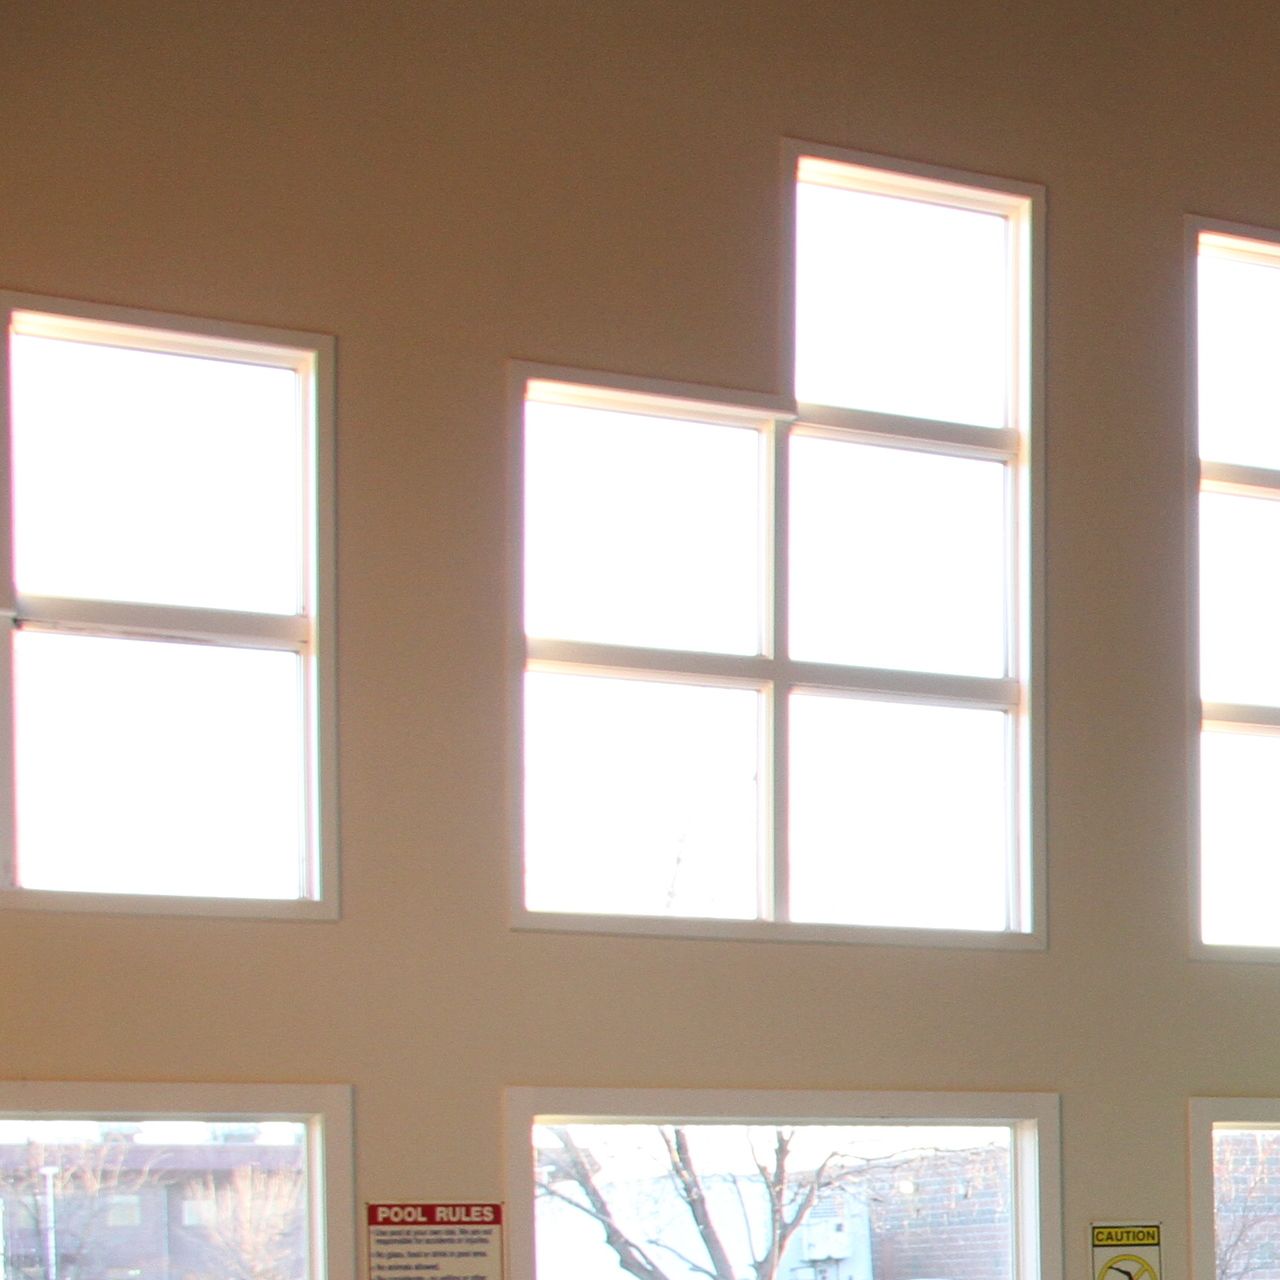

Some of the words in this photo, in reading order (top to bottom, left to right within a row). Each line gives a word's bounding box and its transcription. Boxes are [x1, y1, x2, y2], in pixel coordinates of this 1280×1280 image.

[377, 1207, 427, 1221] POOL
[436, 1207, 494, 1221] RULES
[1095, 1231, 1155, 1242] CAUTION
